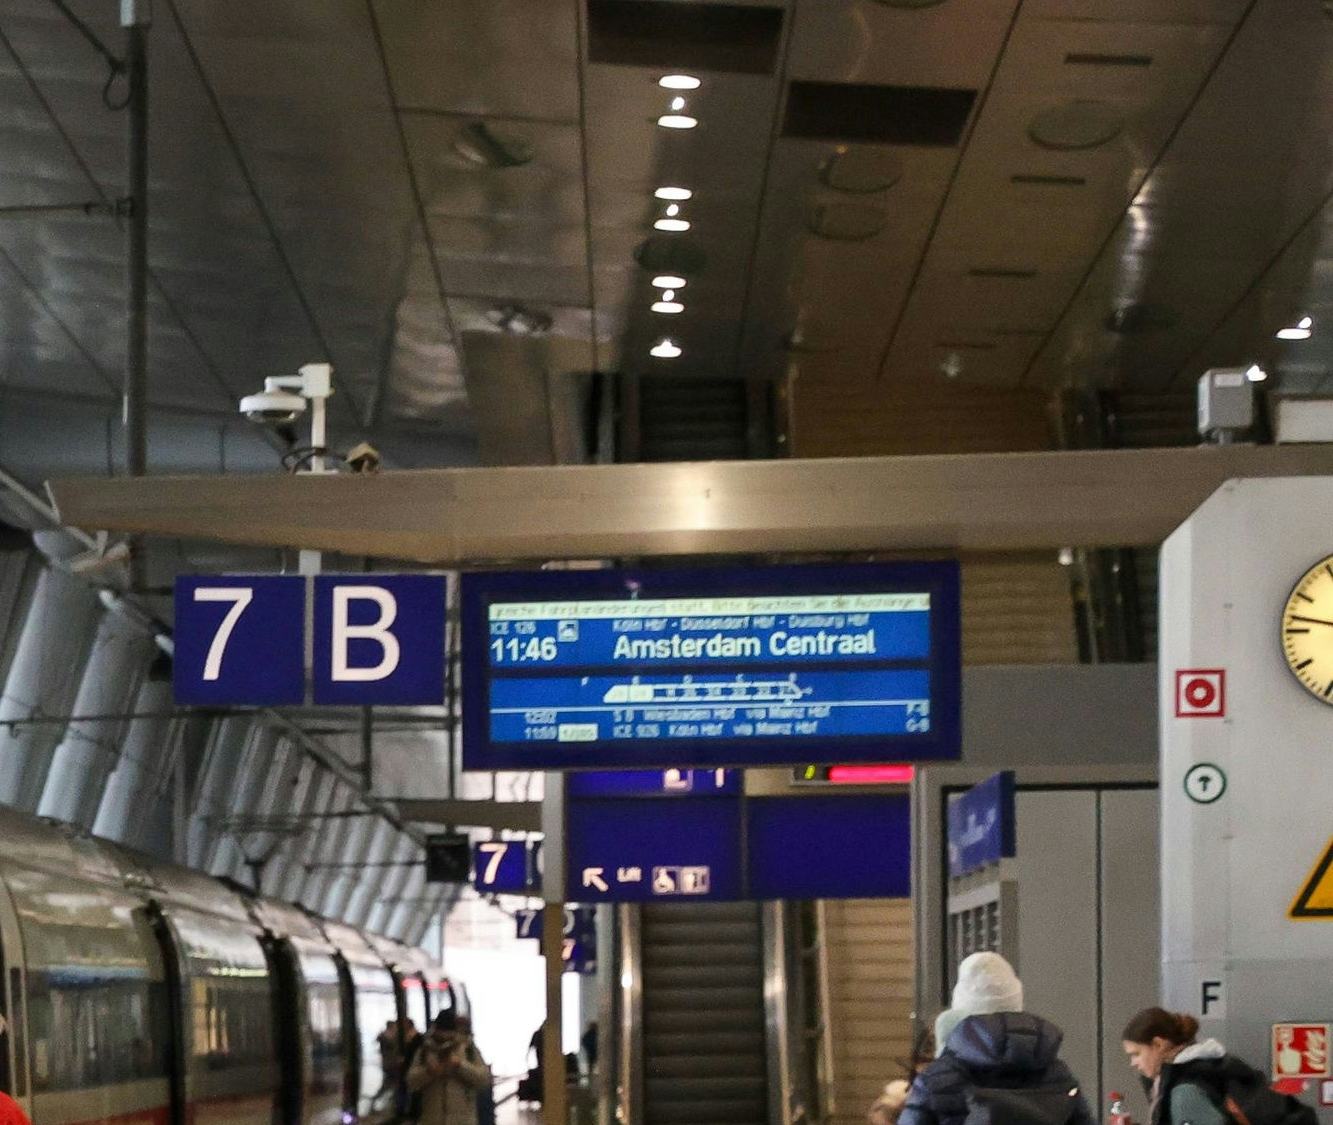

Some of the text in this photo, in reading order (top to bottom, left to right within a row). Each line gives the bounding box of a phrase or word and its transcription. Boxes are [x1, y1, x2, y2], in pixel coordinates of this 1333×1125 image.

[194, 588, 253, 680] 7
[332, 586, 400, 681] B
[491, 636, 557, 661] 11:46
[613, 628, 876, 659] Amsterdam Centraal
[480, 843, 508, 884] 7
[518, 910, 537, 937] 7
[1202, 982, 1221, 1015] F
